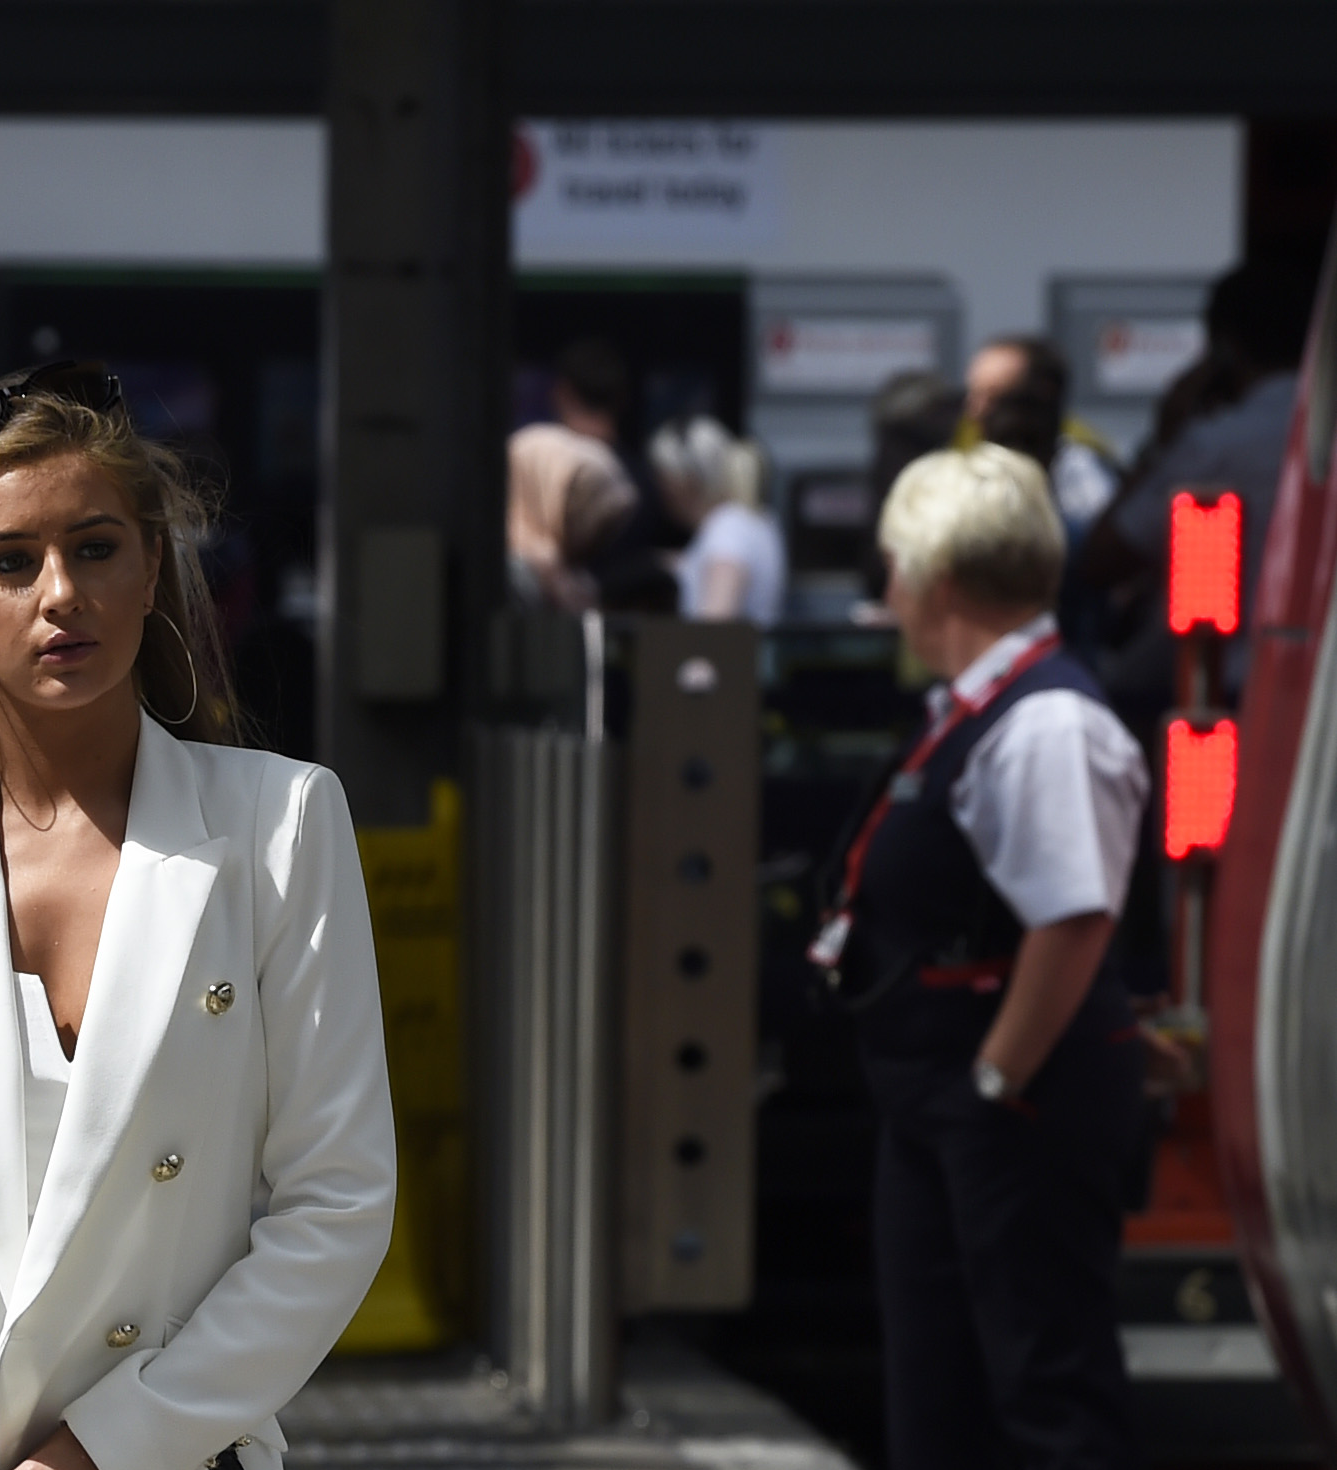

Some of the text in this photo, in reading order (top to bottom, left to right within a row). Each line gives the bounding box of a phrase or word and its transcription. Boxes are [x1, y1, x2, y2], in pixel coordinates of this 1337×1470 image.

[563, 176, 747, 216] travel today
[1177, 1268, 1217, 1322] 6
